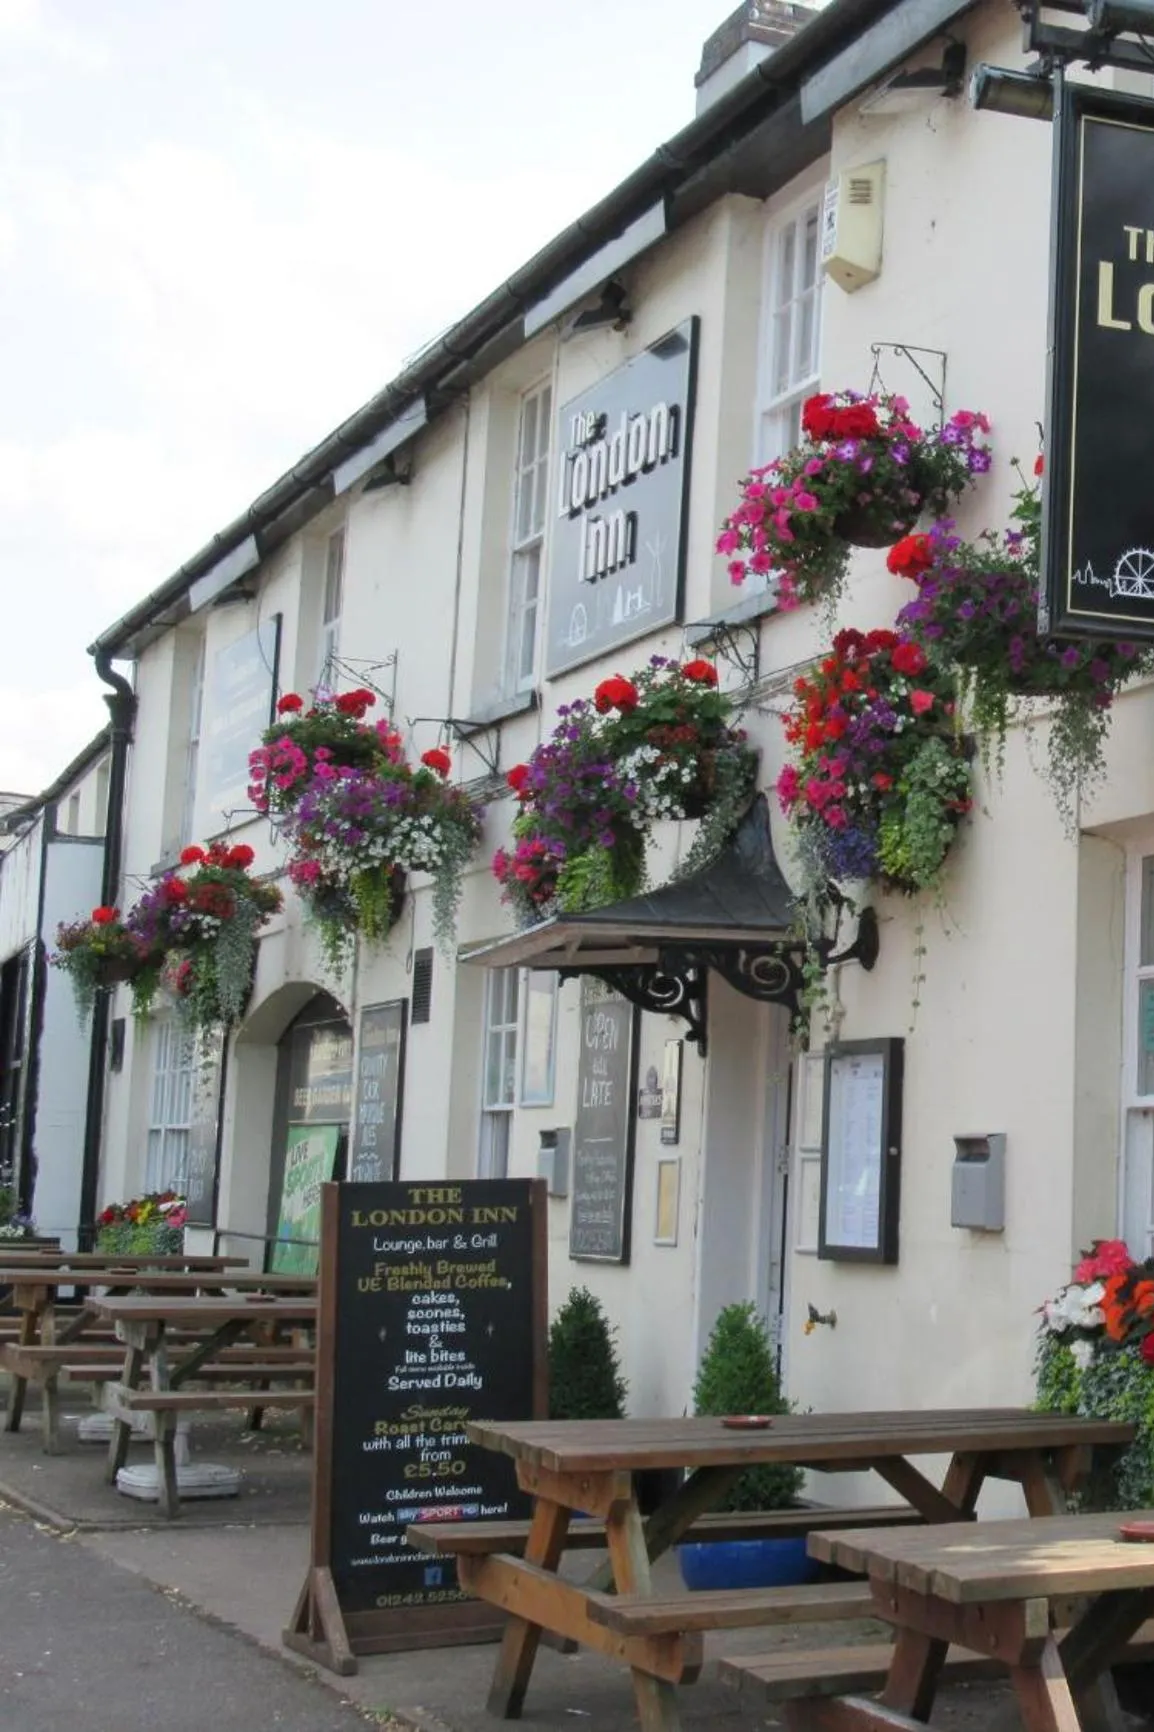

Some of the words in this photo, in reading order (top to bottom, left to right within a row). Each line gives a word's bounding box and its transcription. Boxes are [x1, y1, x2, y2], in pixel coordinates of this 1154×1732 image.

[558, 401, 670, 519] London
[578, 507, 627, 584] Inn
[408, 1188, 462, 1204] THE
[351, 1208, 464, 1227] LONDON
[472, 1206, 518, 1223] INN
[453, 1235, 468, 1250] &
[471, 1233, 498, 1249] Grill
[374, 1261, 431, 1280] Freshly
[436, 1259, 496, 1274] Brewed
[406, 1320, 466, 1335] toasties
[429, 1335, 443, 1349] &
[430, 1349, 466, 1363] bites
[388, 1374, 441, 1391] Served
[445, 1373, 483, 1390] Daily
[401, 1404, 471, 1421] Sunday
[374, 1420, 425, 1436] Roast
[363, 1437, 391, 1452] with
[396, 1436, 411, 1449] all
[416, 1435, 436, 1448] the
[420, 1448, 451, 1462] from
[386, 1488, 433, 1501] Children
[435, 1485, 483, 1498] Welcome
[359, 1511, 395, 1525] Watch
[370, 1533, 398, 1546] Beer
